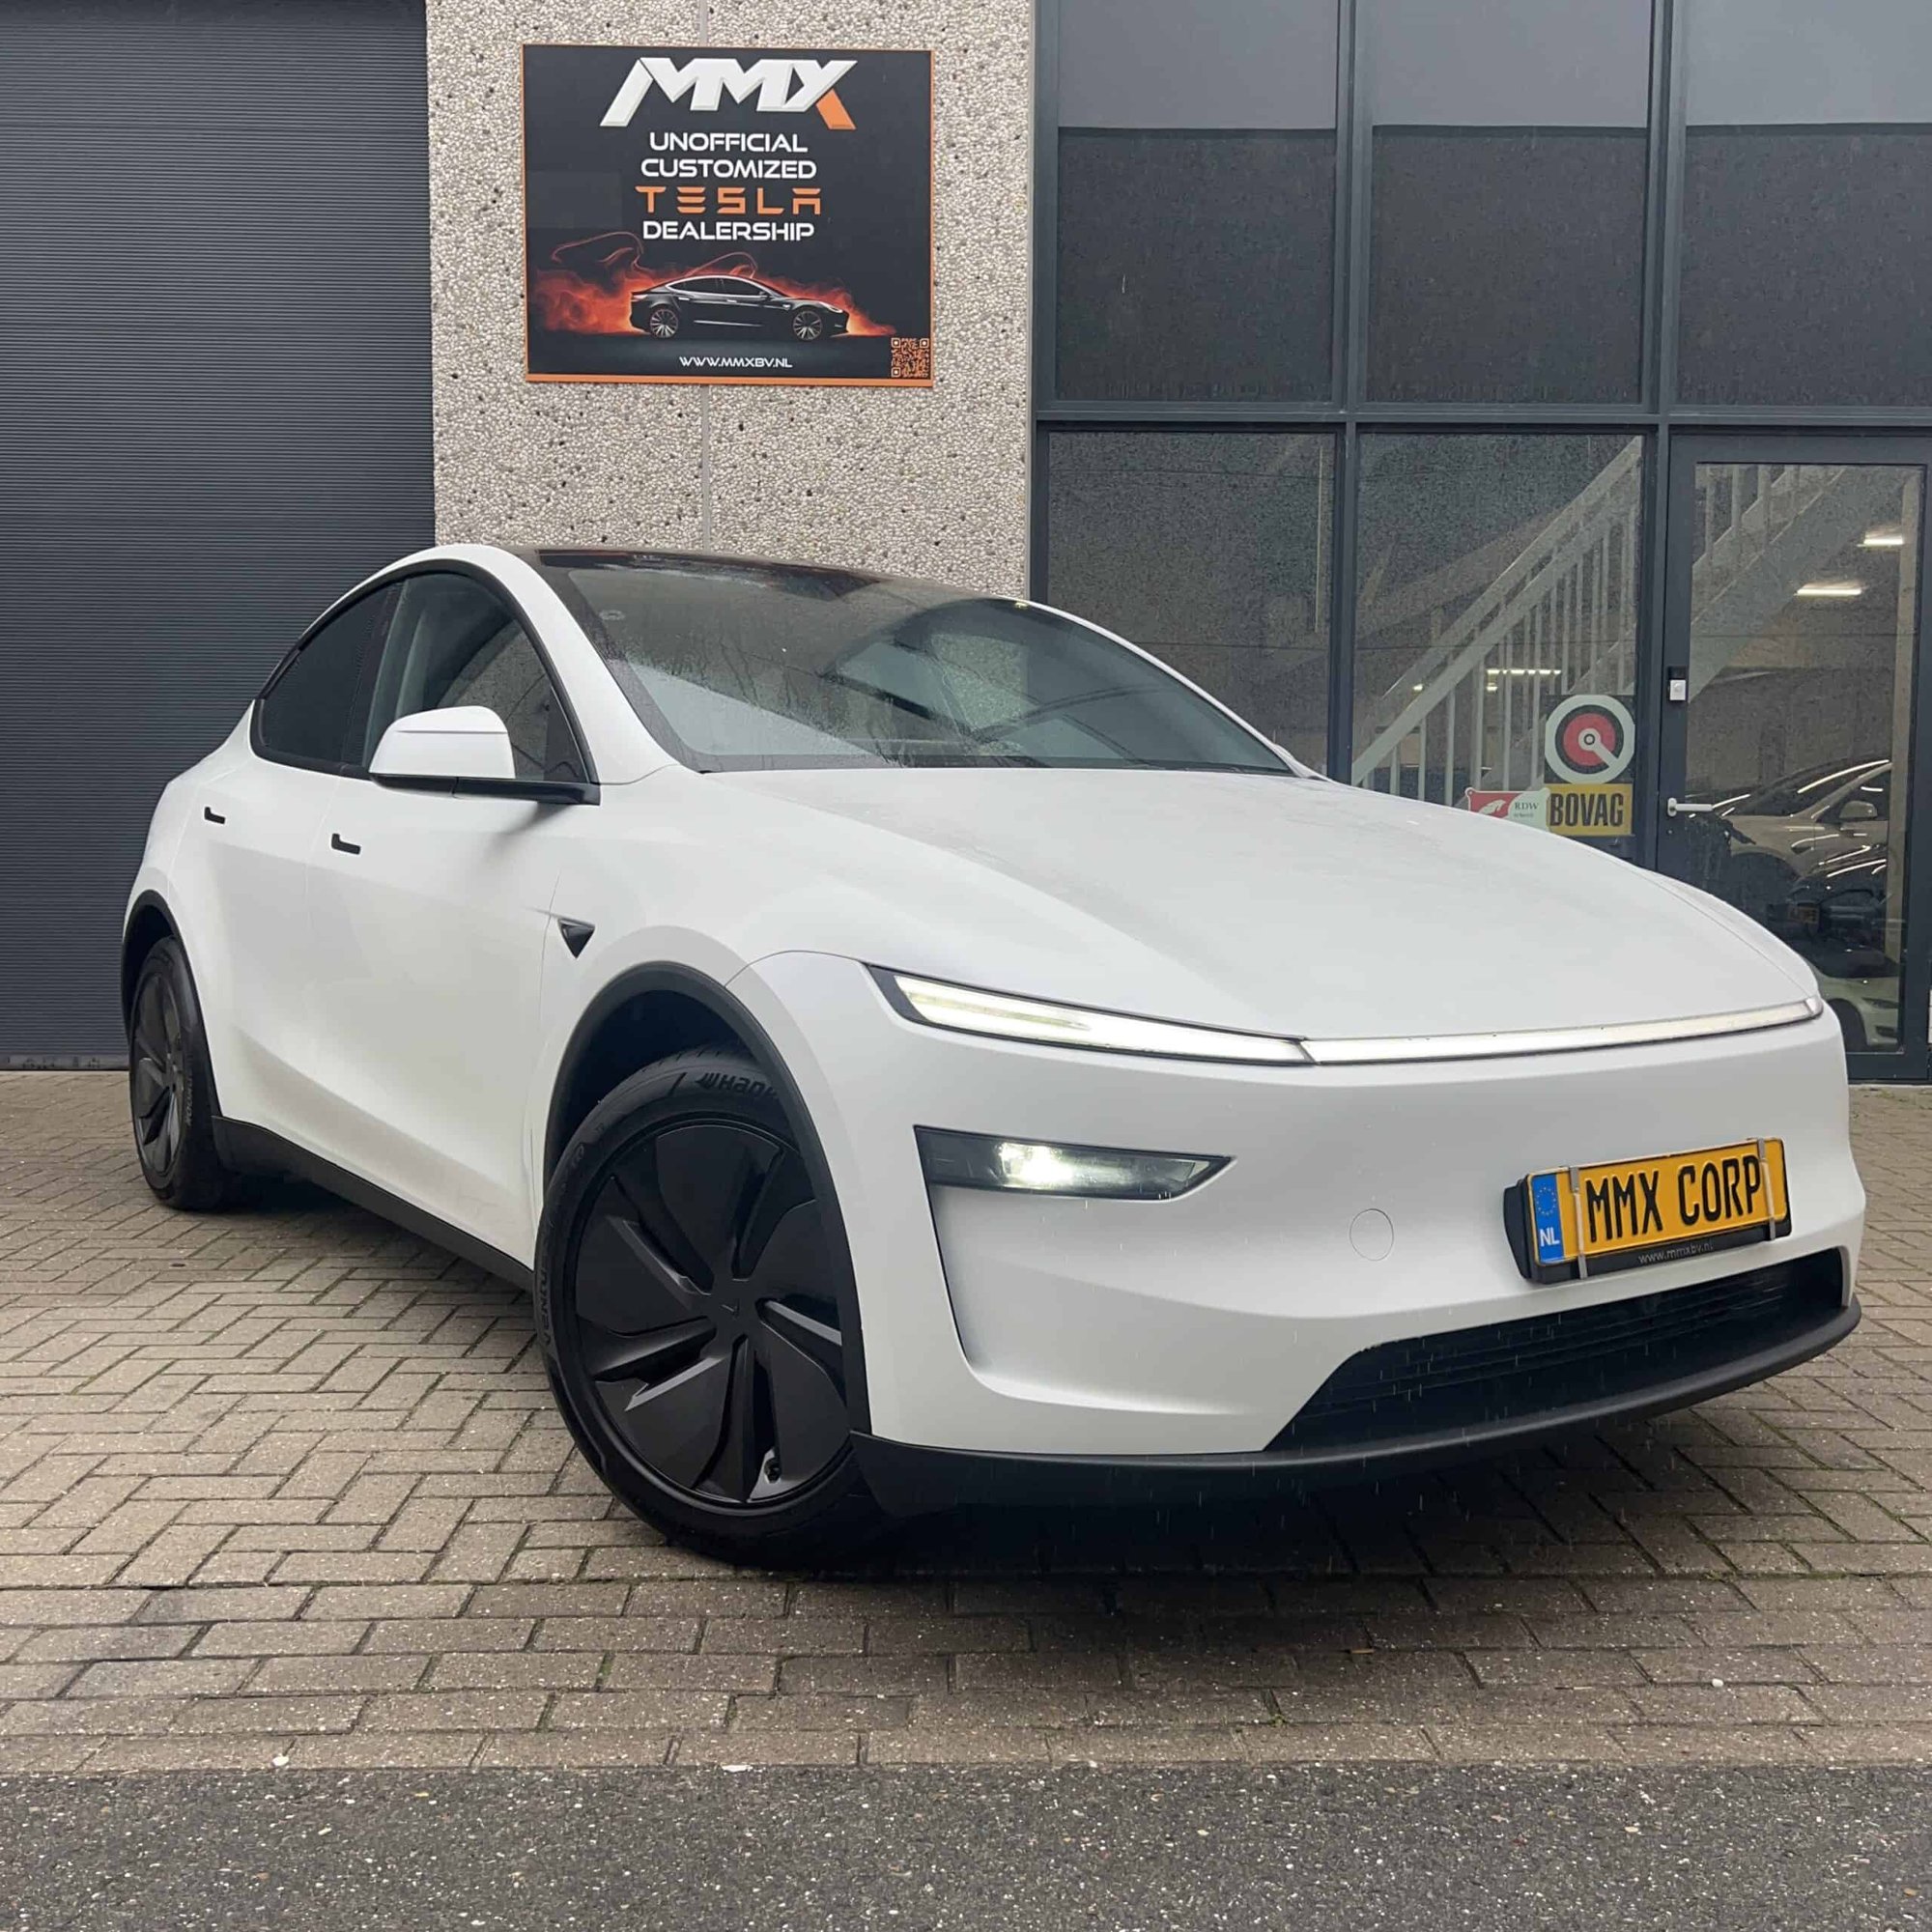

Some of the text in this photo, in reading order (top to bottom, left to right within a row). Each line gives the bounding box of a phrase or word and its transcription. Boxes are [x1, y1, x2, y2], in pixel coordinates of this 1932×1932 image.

[600, 57, 858, 129] MMX
[649, 132, 808, 153] UNOFFICIAL
[640, 158, 817, 179] CUSTOMIZED
[635, 185, 821, 214] TESLA
[642, 221, 814, 241] DEALERSHIP
[678, 356, 793, 368] WWW.MMXBV.NL
[1549, 792, 1625, 827] BOVAG
[1584, 1153, 1762, 1243] MMX CORP
[1539, 1227, 1560, 1247] NL
[1637, 1237, 1715, 1265] www.mmxbv.nl
